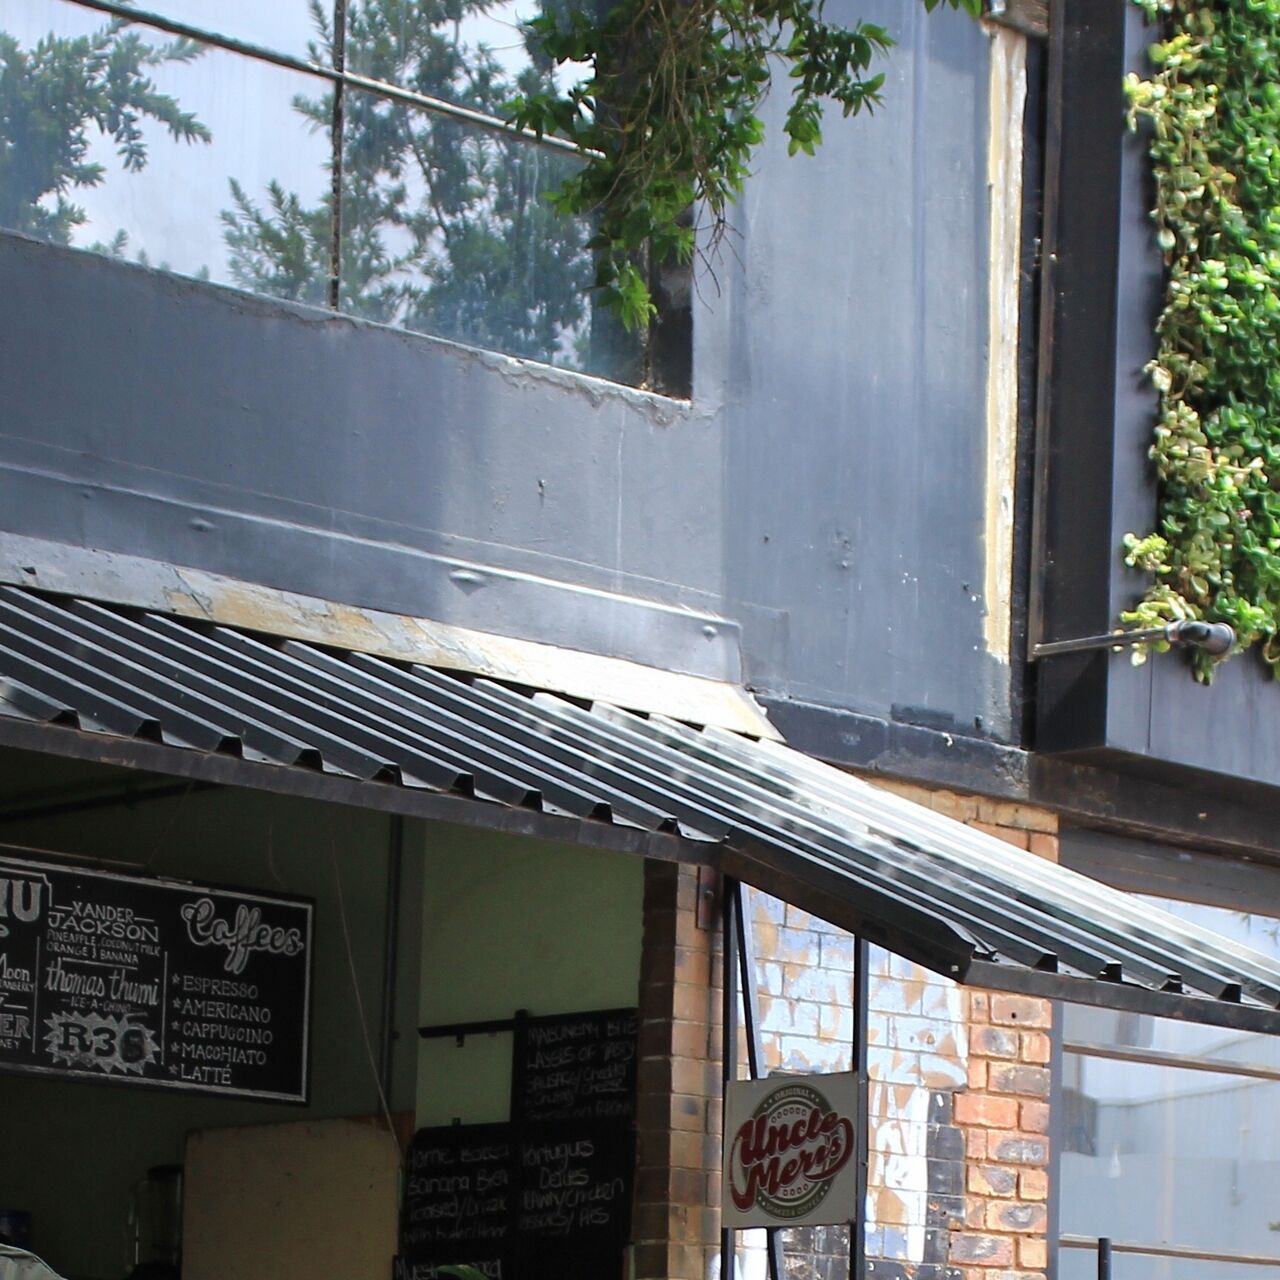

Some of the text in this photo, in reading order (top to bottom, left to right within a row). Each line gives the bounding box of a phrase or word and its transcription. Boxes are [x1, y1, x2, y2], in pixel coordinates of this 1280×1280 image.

[72, 900, 134, 924] XANDER
[48, 910, 159, 943] JACKSON
[180, 898, 305, 975] Coffees
[46, 941, 89, 957] ORANGE
[100, 948, 139, 964] BANANA
[44, 957, 105, 997] thomas
[182, 975, 259, 1000] ESPRESSO
[180, 998, 271, 1024] AMERICANO
[182, 1021, 273, 1045] CAPPUCCINO
[181, 1042, 268, 1066] MACCHIATO
[734, 1107, 839, 1165] Uncle
